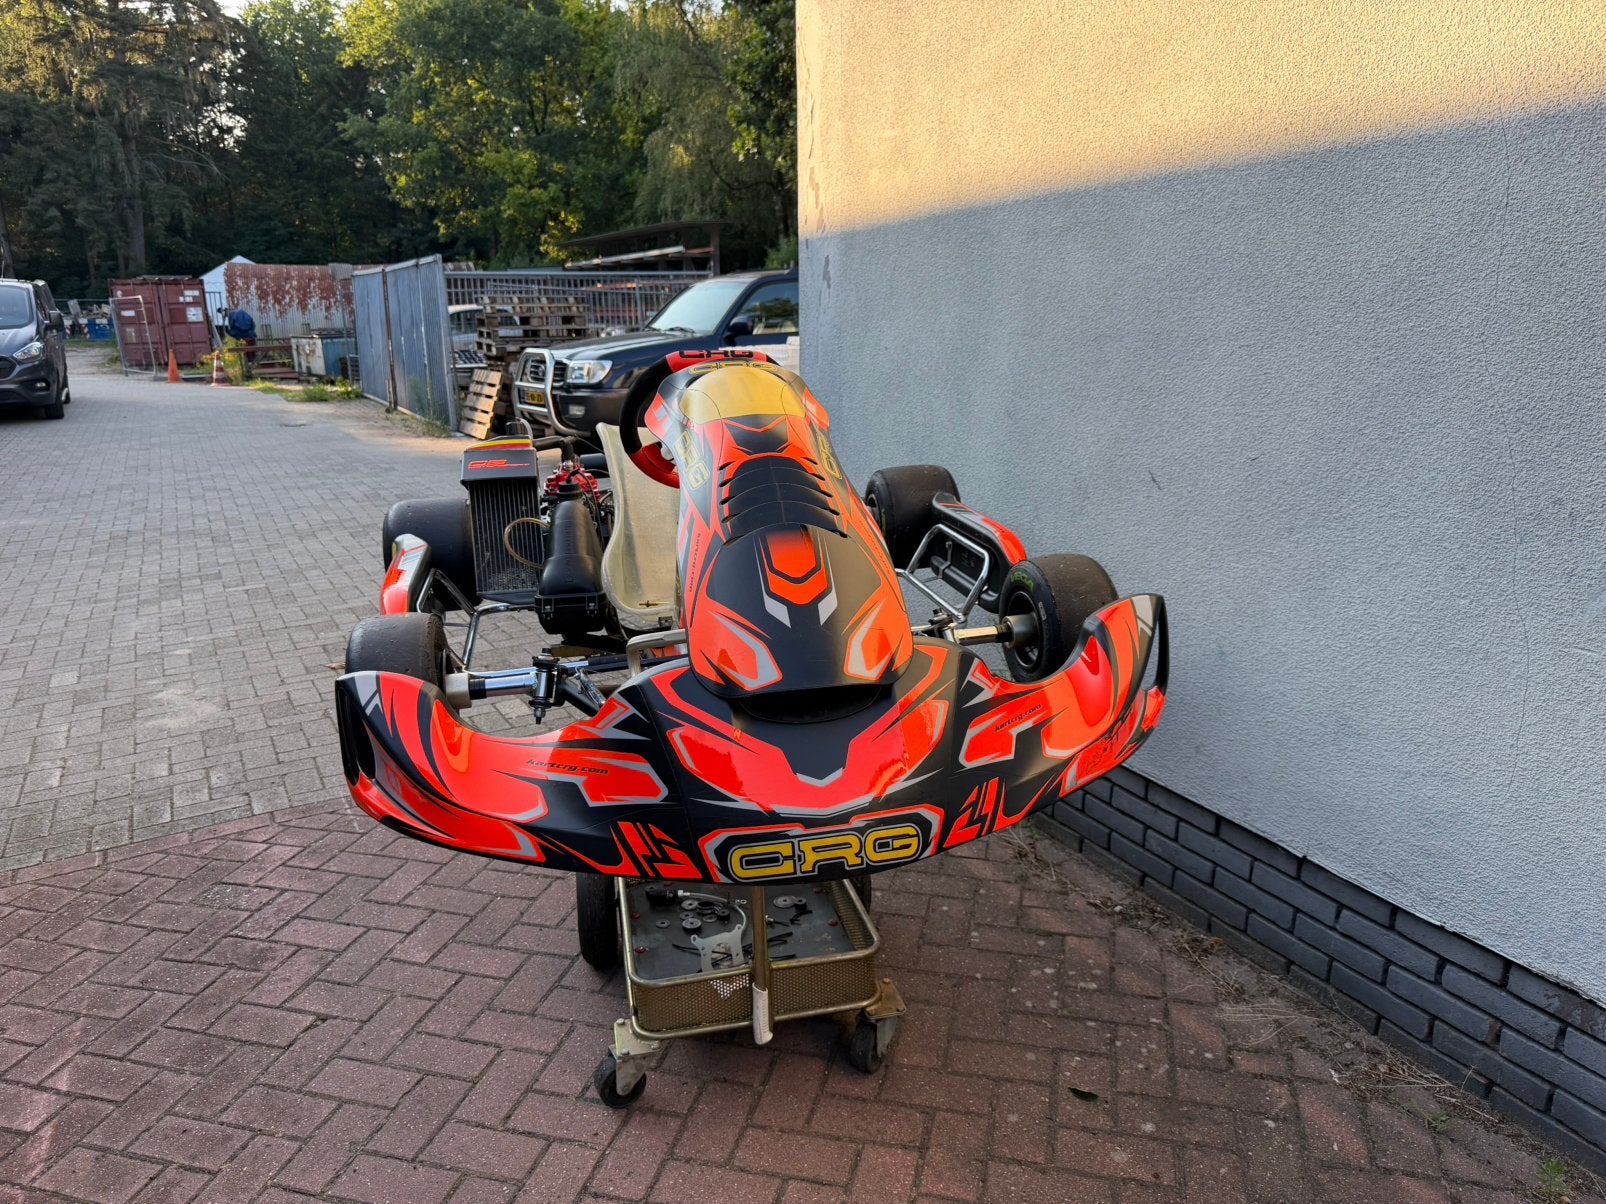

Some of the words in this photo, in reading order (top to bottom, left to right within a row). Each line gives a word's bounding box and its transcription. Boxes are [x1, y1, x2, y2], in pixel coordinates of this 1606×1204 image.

[995, 704, 1042, 732] kartcrg.com
[527, 759, 609, 775] kartcrg.com
[728, 823, 922, 883] CRG
